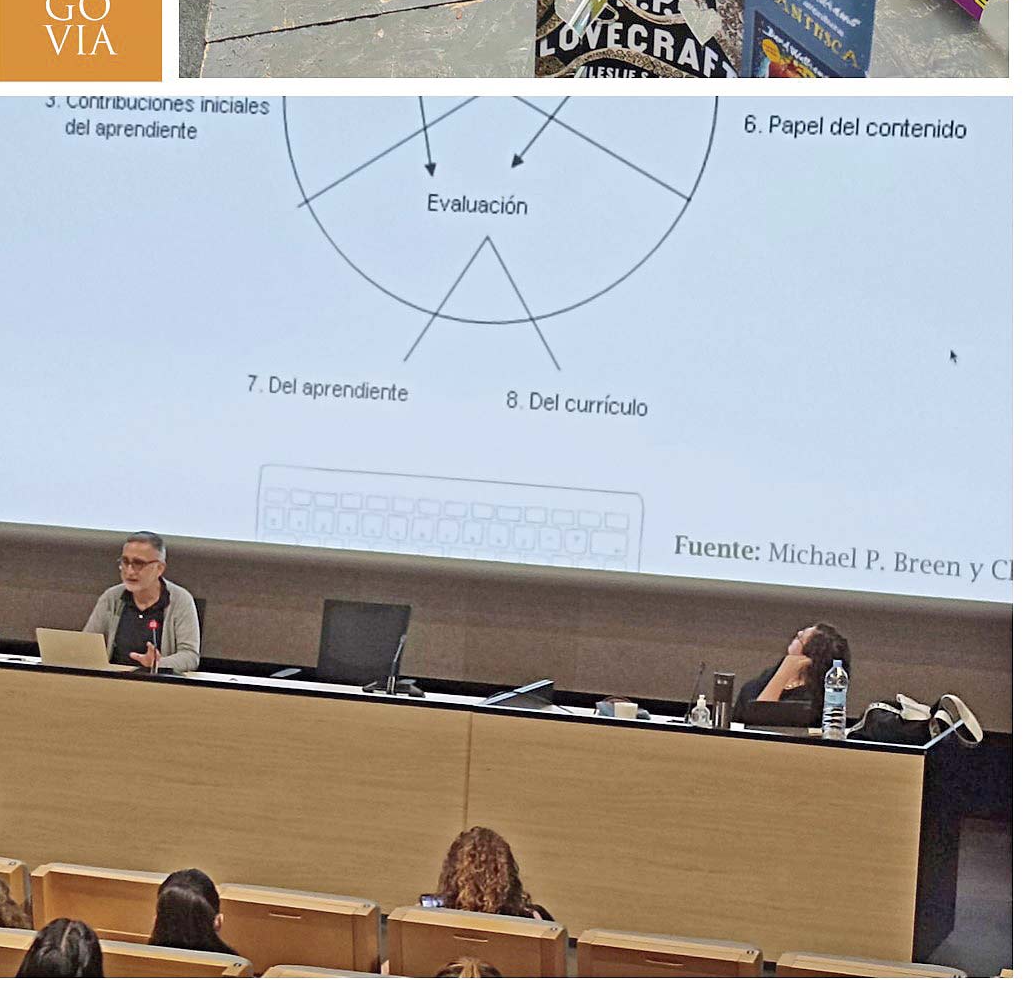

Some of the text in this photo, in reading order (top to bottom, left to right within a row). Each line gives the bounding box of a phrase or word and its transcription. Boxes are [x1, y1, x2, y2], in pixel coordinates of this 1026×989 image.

[65, 119, 198, 140] del aprendiente
[745, 115, 967, 139] 6. Papel del contenido
[427, 194, 528, 215] Evaluación
[248, 375, 409, 401] 7. Del aprendiente
[506, 391, 648, 416] 8. Del currículo
[674, 535, 760, 560] Fuente:
[769, 543, 856, 568] Michael
[866, 550, 885, 571] P.
[894, 553, 961, 577] Breen
[970, 563, 983, 582] y
